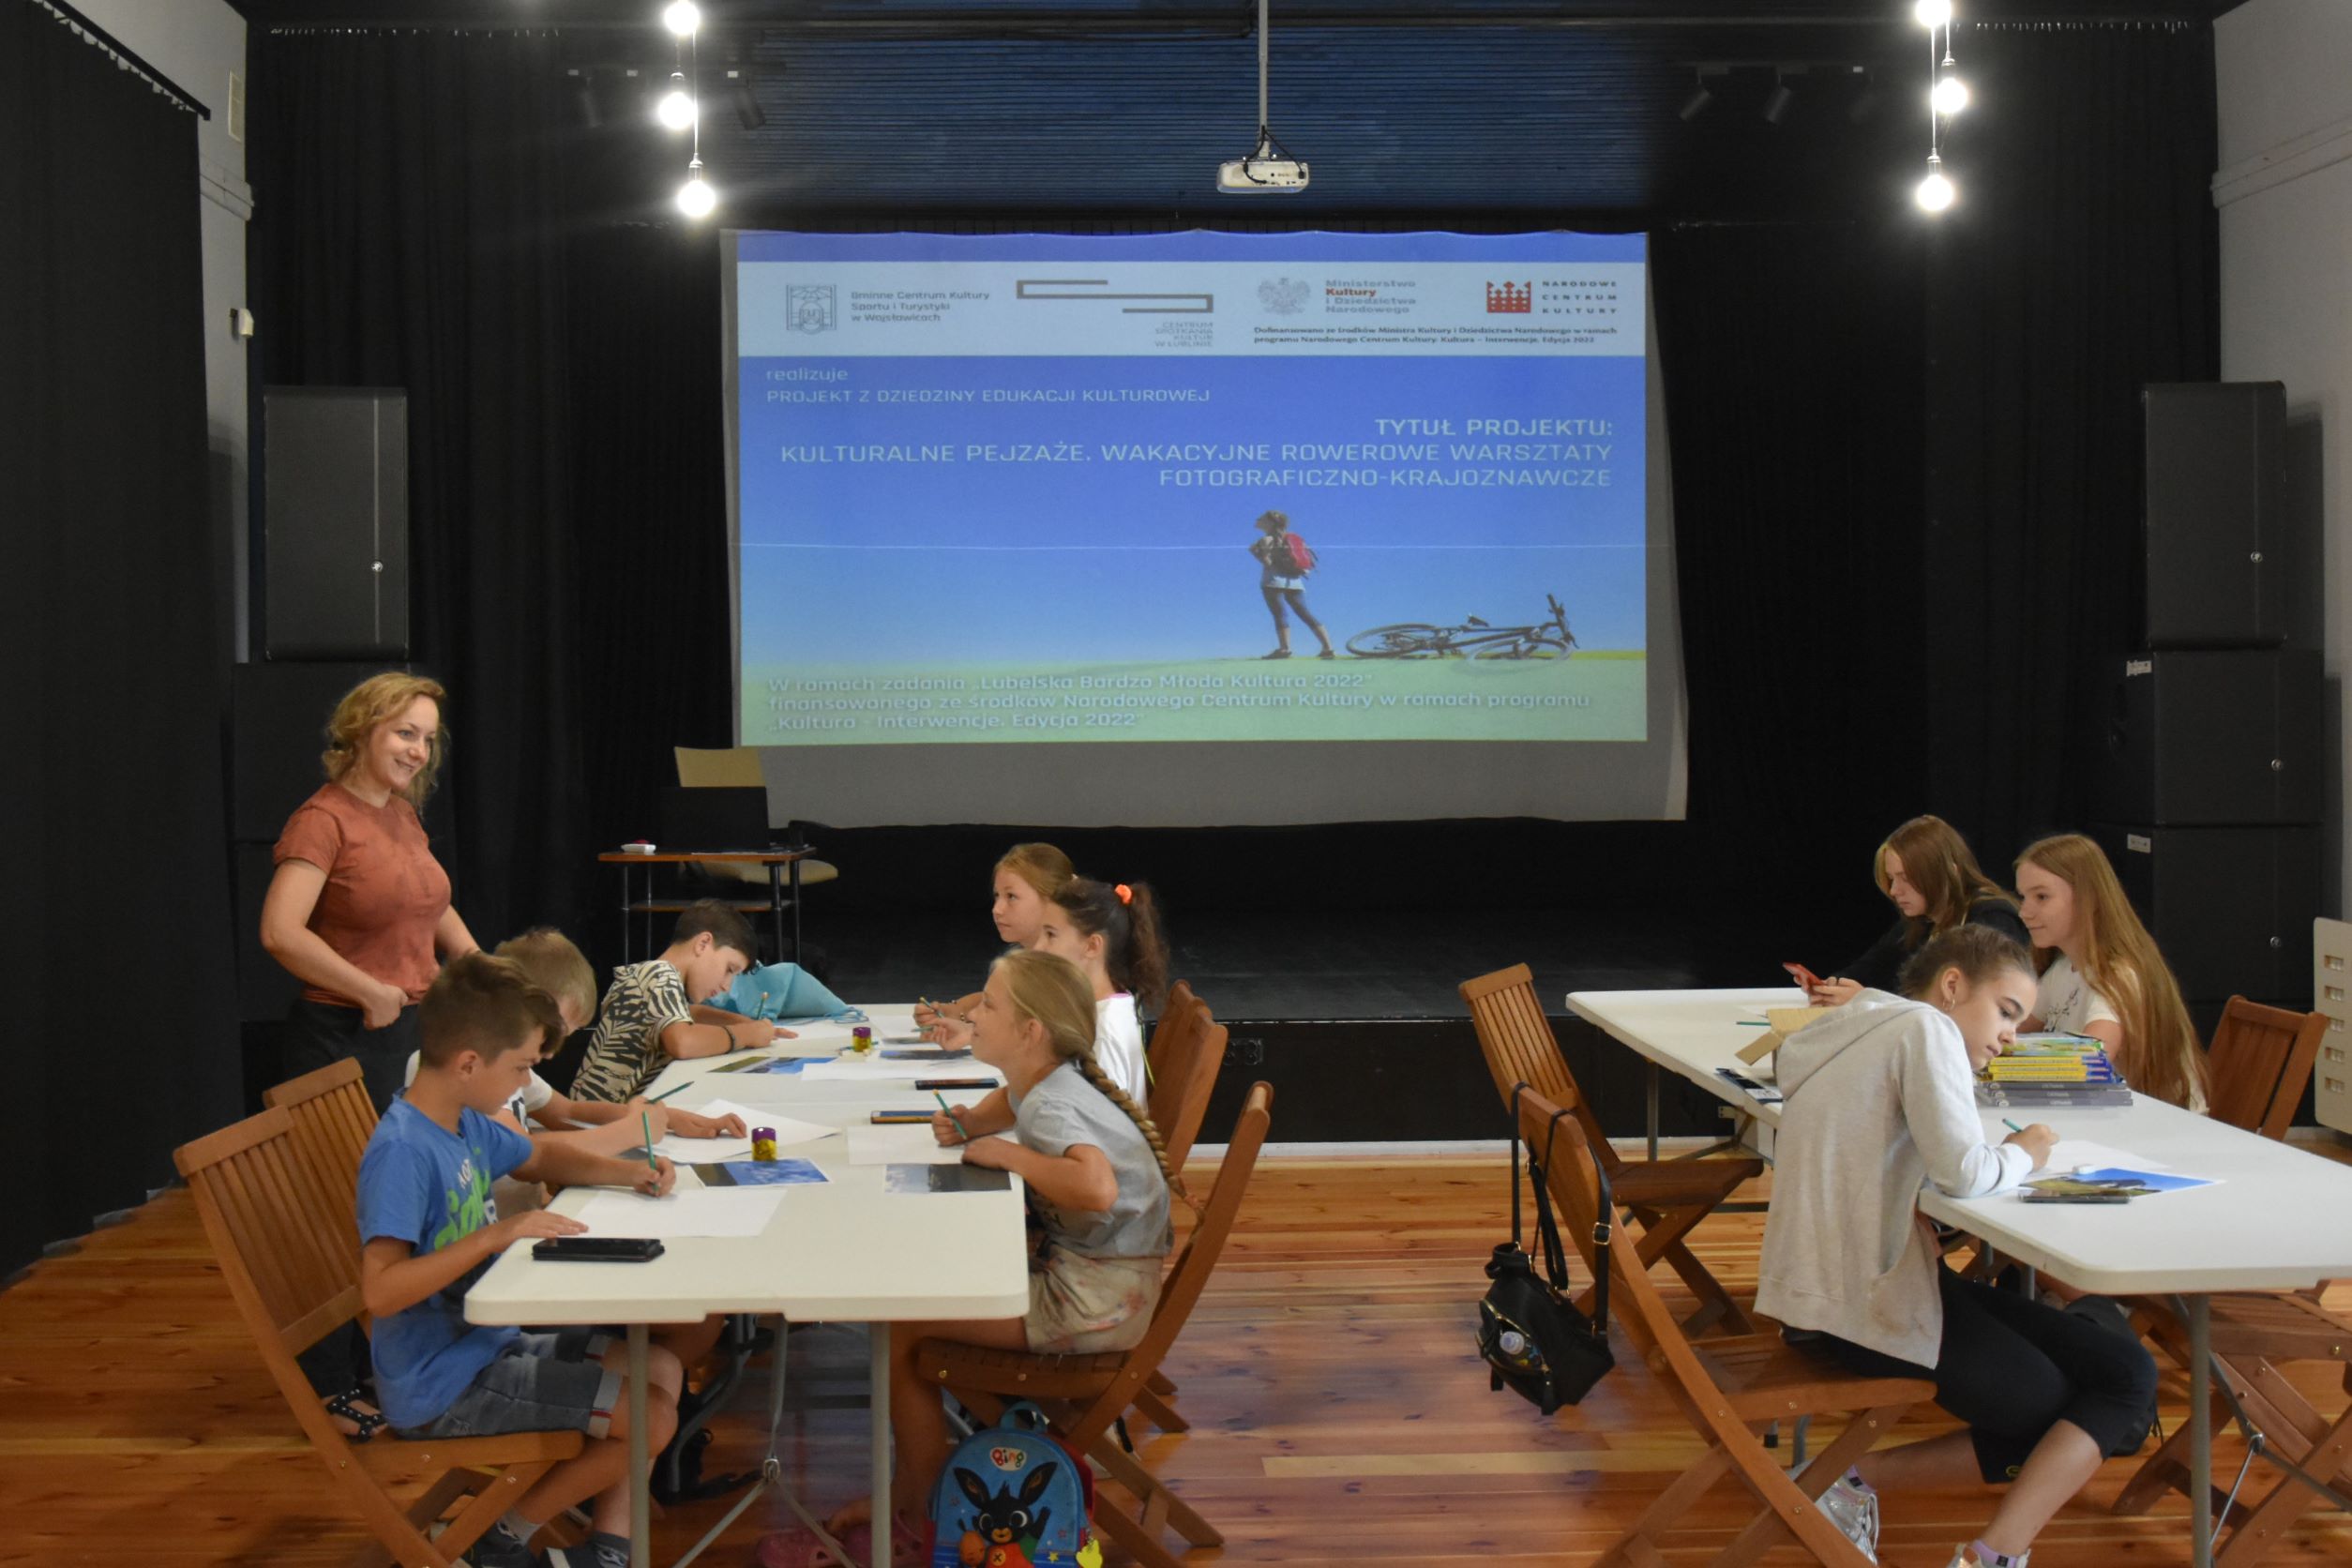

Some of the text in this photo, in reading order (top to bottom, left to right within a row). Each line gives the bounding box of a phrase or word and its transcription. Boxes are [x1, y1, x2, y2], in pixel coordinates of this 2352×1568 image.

[897, 292, 946, 300] Centrum
[949, 292, 990, 301] Kultury
[1325, 288, 1377, 297] Kultury
[851, 303, 890, 311] Sportu
[900, 303, 950, 312] Turystyki
[1417, 326, 1452, 335] Kultury
[766, 368, 850, 384] realizuje
[766, 388, 1211, 403] PROJEKT Z DZIEDZINY EDUKACJI KULTUROWEJ
[1375, 419, 1613, 437] TYTUŁ PROJEKTU:
[780, 445, 956, 463] KULTURALNE
[1101, 444, 1271, 462] WAKACYJNE
[1281, 444, 1440, 461] ROWEROWE
[1450, 444, 1614, 461] WARSZTATY
[1159, 468, 1613, 487] FOTOGRAFICZNO-KRAJOZNAWCZE
[768, 679, 789, 691] W
[797, 679, 876, 691] ramach
[882, 677, 965, 691] zadania
[1079, 674, 1153, 689] Bardzo
[1159, 673, 1224, 688] Młoda
[1229, 673, 1307, 687] Kultura
[768, 697, 932, 714] finansowanego
[939, 696, 962, 709] ze
[1063, 693, 1195, 709] Narodowego
[1201, 693, 1291, 706] Centrum
[1298, 692, 1373, 709] Kultury
[1380, 695, 1396, 706] w
[1404, 692, 1482, 706] ramach
[1487, 693, 1591, 709] programu
[1012, 713, 1078, 728] Edycja
